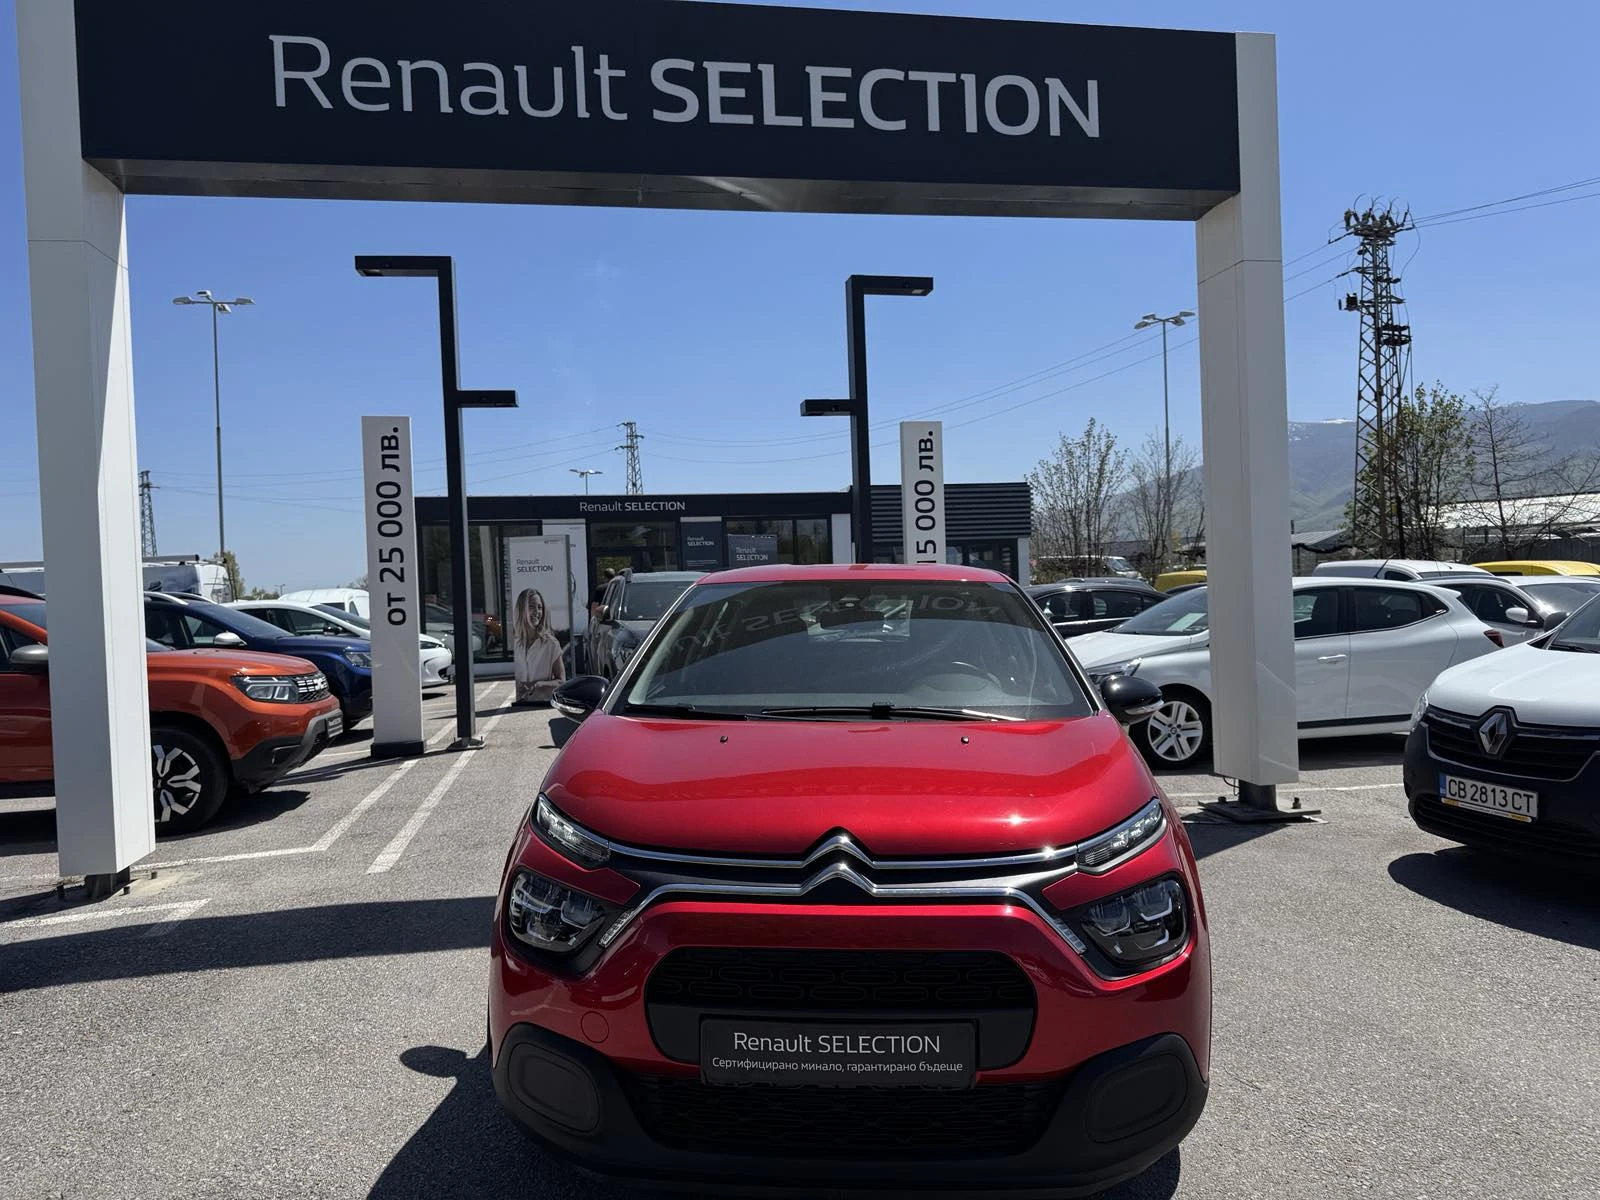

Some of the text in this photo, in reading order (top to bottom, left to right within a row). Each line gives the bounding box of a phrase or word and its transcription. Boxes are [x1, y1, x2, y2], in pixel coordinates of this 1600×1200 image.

[269, 34, 1100, 138] Renault SELECTION
[918, 431, 934, 472] лв.
[580, 501, 686, 512] Renault SELECTION
[914, 480, 936, 531] 000
[376, 427, 407, 626] от 25 000 лв.
[517, 565, 553, 573] SELECTION
[1448, 779, 1467, 799] CB
[1470, 784, 1508, 808] 2813
[1512, 791, 1534, 814] CT
[734, 1032, 941, 1054] Renault SELECTION
[712, 1057, 963, 1073] Сертифицирано минало, гарантирано бъдеще
